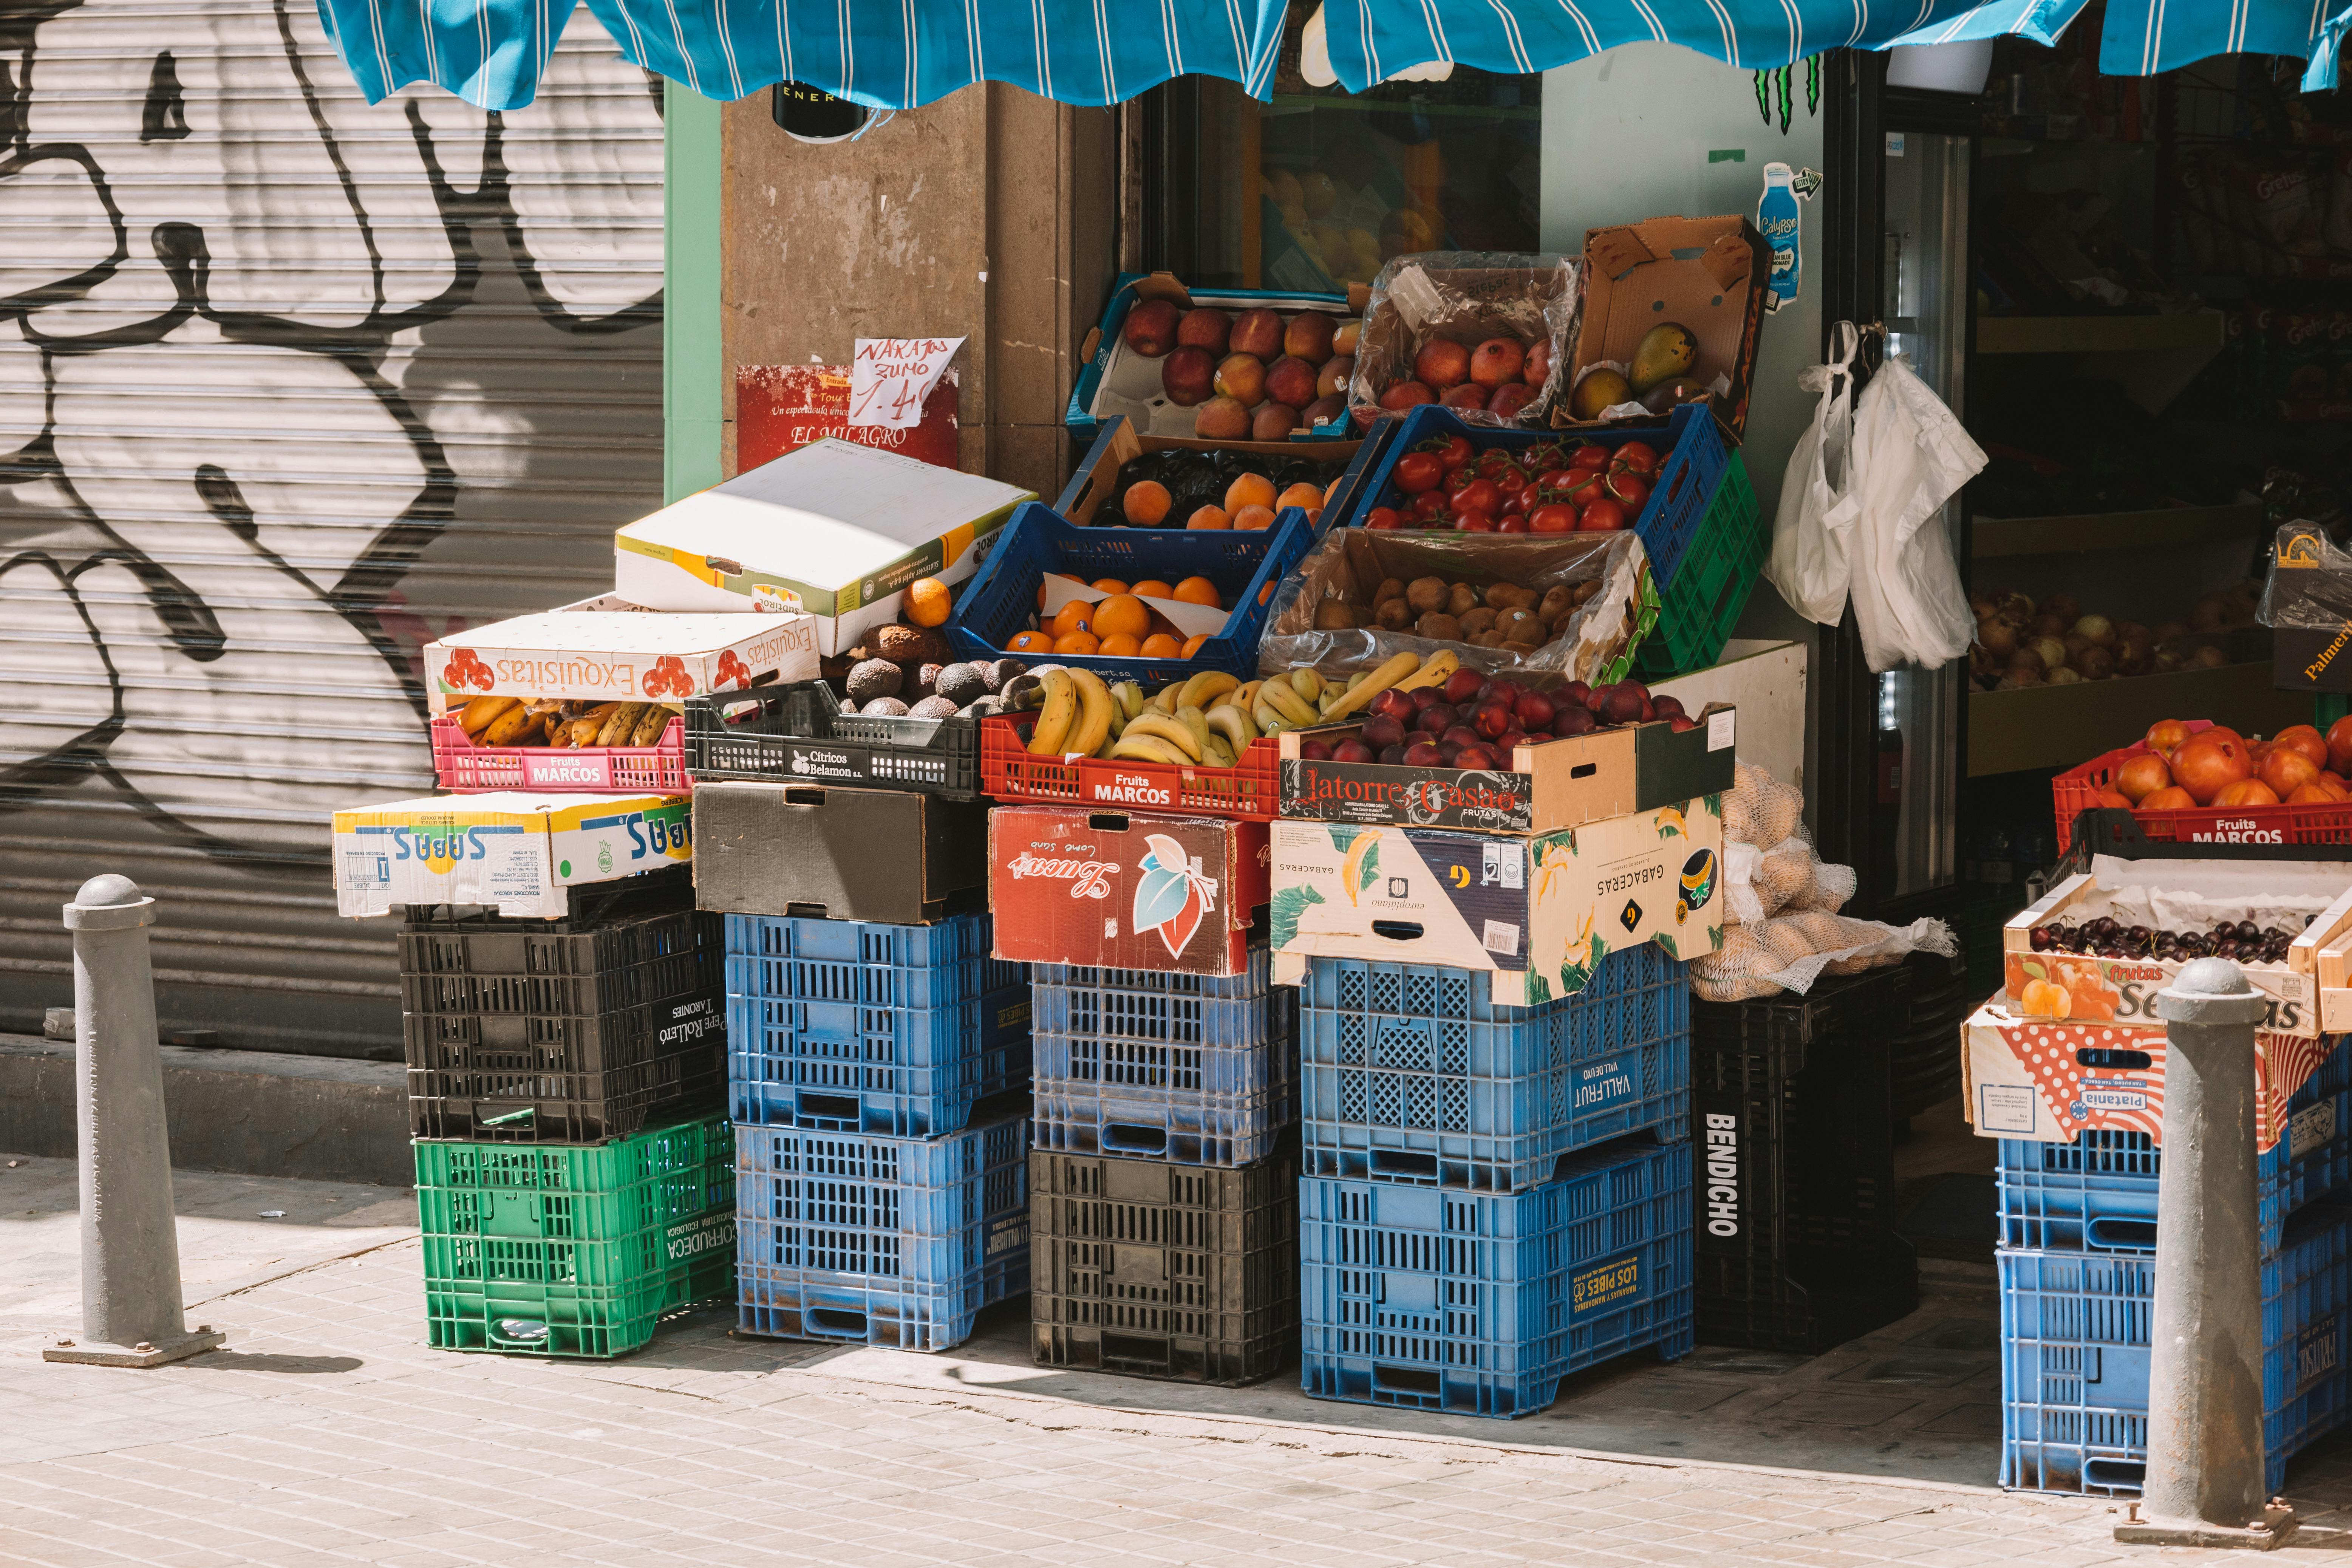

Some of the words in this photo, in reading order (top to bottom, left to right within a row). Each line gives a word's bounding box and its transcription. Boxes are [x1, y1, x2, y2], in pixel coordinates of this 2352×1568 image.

[1796, 178, 1809, 187] ESTOY
[1761, 215, 1798, 236] Calypso
[874, 362, 929, 379] ZUMO
[772, 405, 785, 416] Un
[791, 426, 816, 444] EL
[819, 426, 906, 448] MILAGRO
[890, 563, 911, 576] geografische
[916, 560, 939, 576] Südtiroler
[878, 572, 891, 582] Angabe
[888, 575, 902, 589] g.g.A.
[902, 570, 915, 583] Apfel
[550, 757, 581, 766] Fruits
[810, 751, 847, 764] Cítricos
[533, 767, 601, 782] MARCOS
[810, 764, 852, 777] Belamon
[1116, 774, 1149, 787] Fruits
[661, 796, 683, 806] ICEBERG
[1095, 785, 1170, 804] MARCOS
[1463, 809, 1497, 818] FRUTAS
[2216, 818, 2256, 831] Fruits
[2192, 829, 2283, 844] MARCOS
[394, 827, 486, 861] SABAS
[1030, 841, 1056, 854] sano
[1279, 864, 1334, 874] GABACERAS
[1612, 864, 1628, 872] CANARIAS
[1597, 864, 1664, 896] GABACERAS
[1372, 899, 1425, 911] europlátano
[2109, 964, 2163, 983] frutas
[704, 1013, 727, 1031] PEPE
[1583, 1067, 1596, 1080] UXO
[1596, 1064, 1604, 1077] DE
[1604, 1061, 1618, 1074] VALL
[1575, 1074, 1631, 1108] VALLFRUT
[2086, 1094, 2142, 1107] Platania
[1706, 1113, 1738, 1237] BENDICHO
[667, 1220, 699, 1238] ECOLOGICA
[1617, 1264, 1637, 1287] LOS
[1587, 1271, 1615, 1297] PIBES
[1610, 1284, 1637, 1300] NARANJAS
[1574, 1294, 1606, 1313] MANDARINAS
